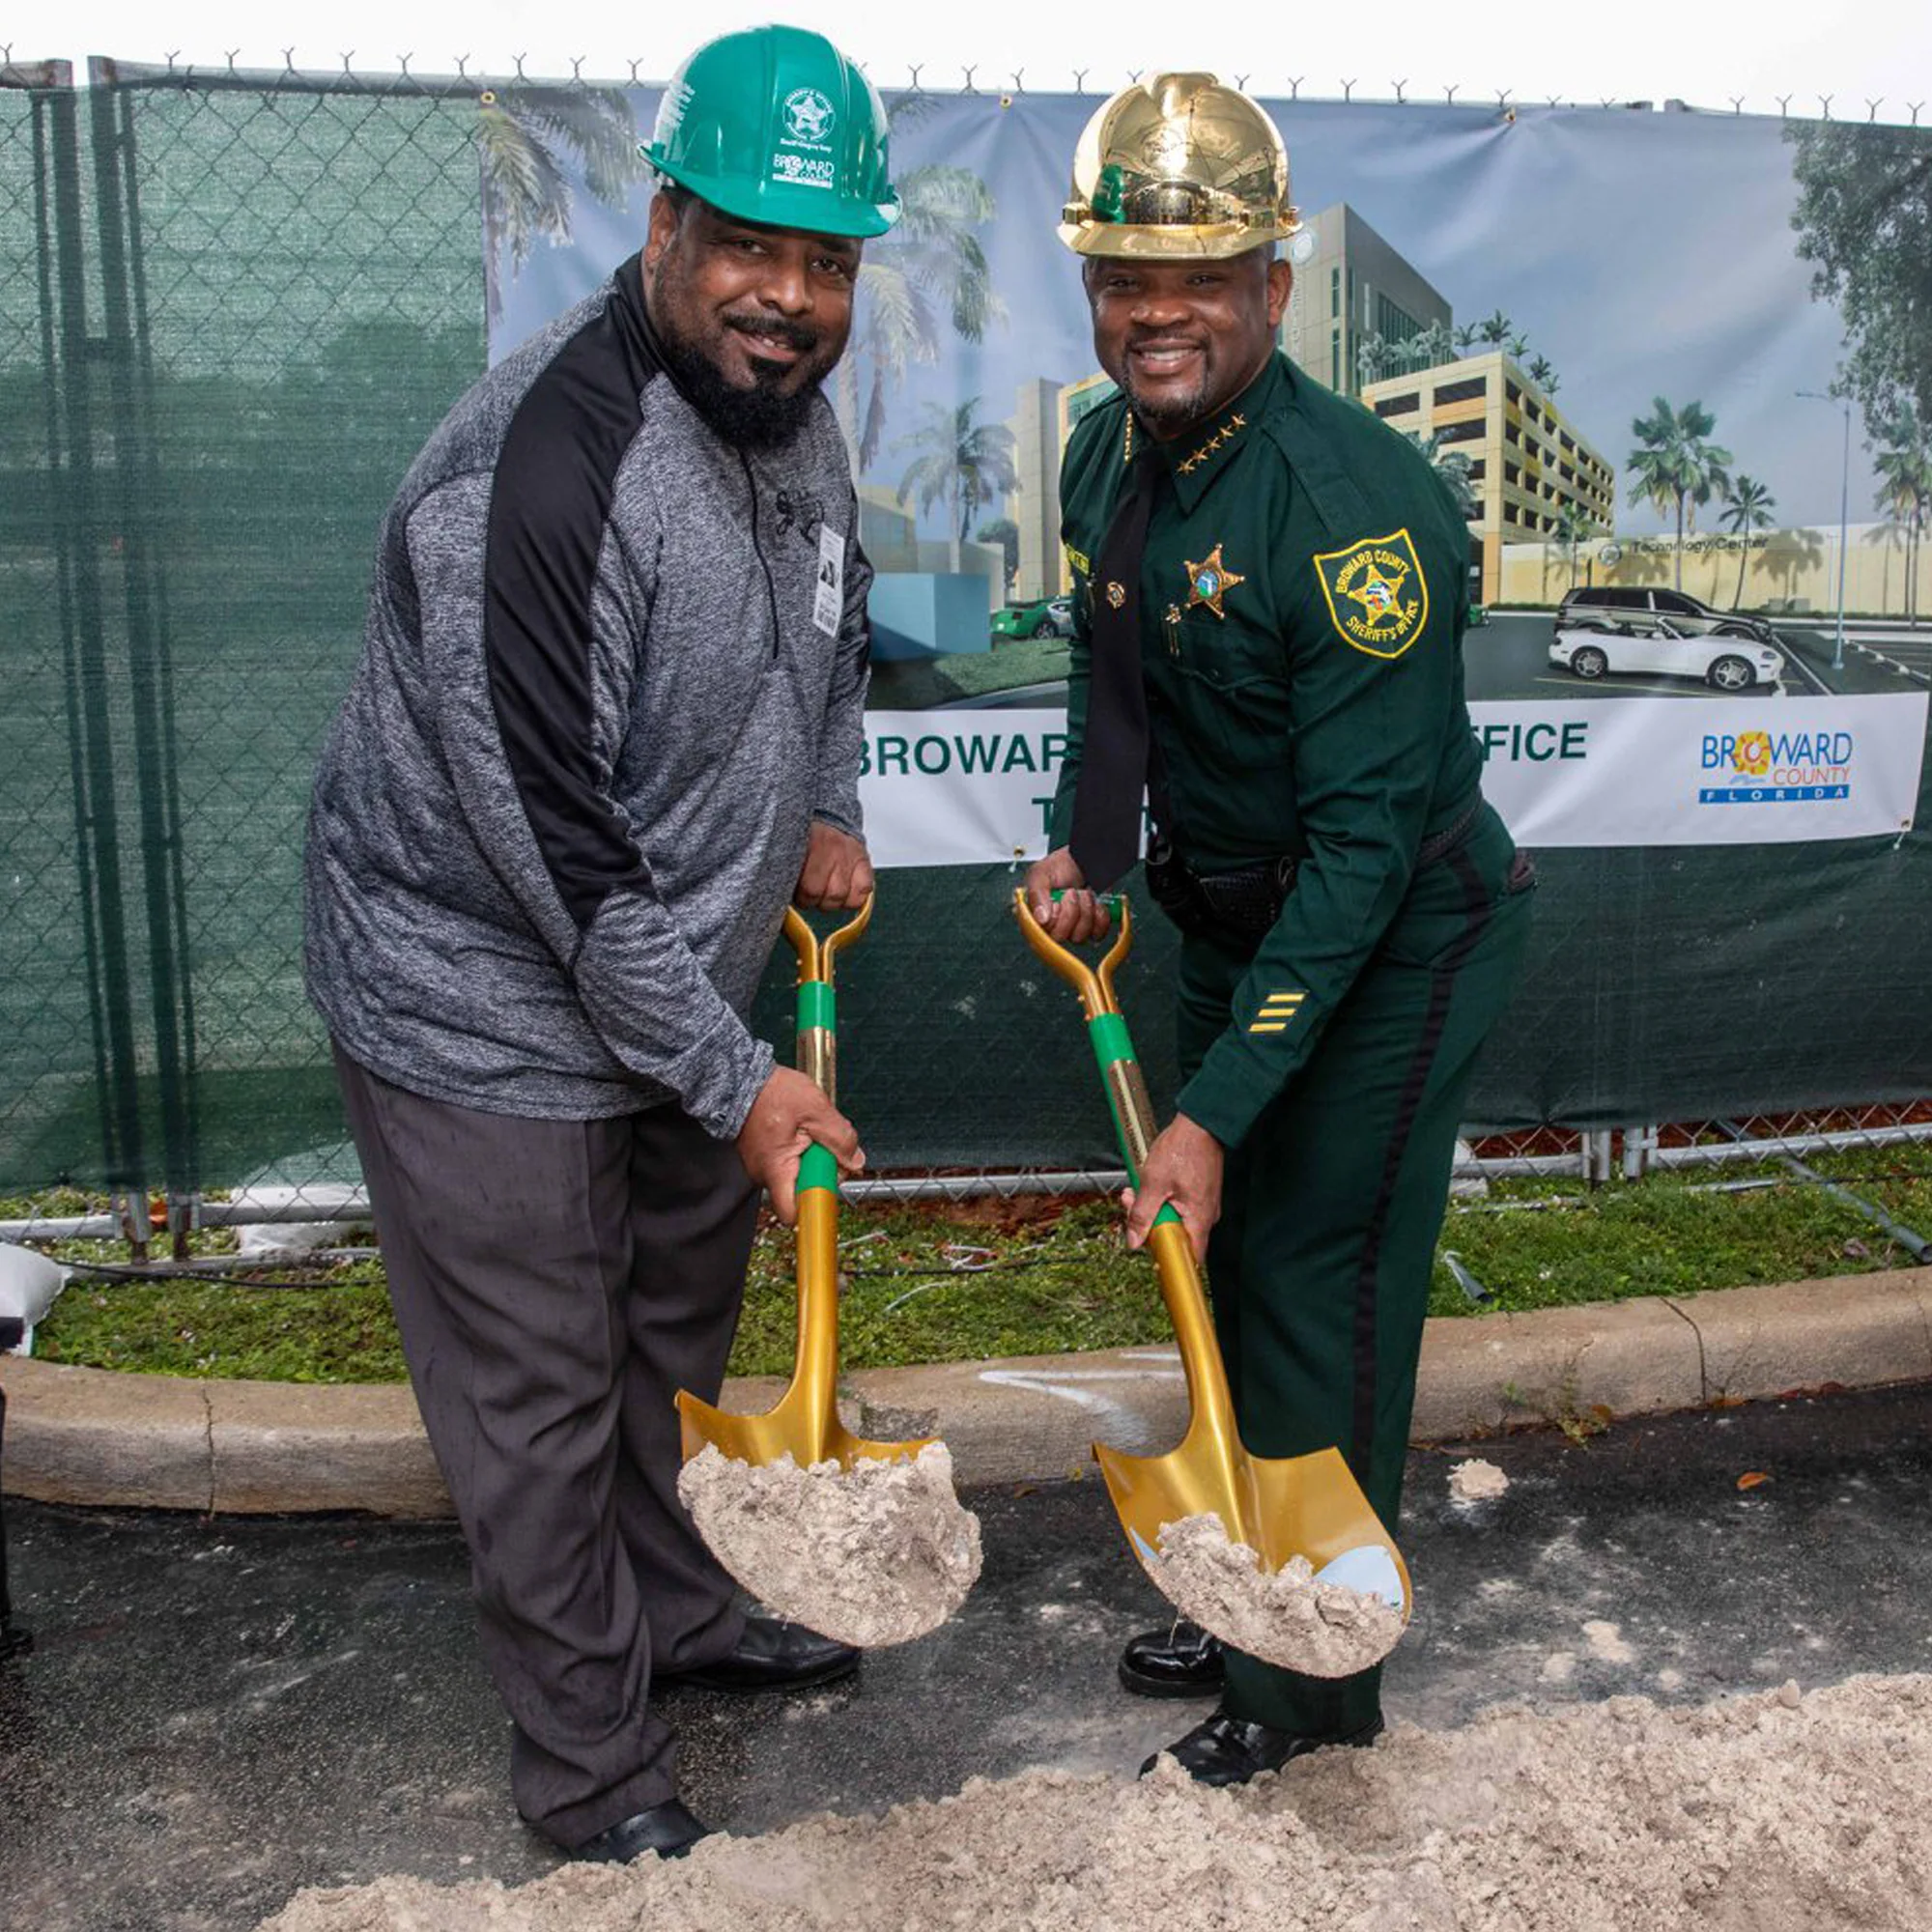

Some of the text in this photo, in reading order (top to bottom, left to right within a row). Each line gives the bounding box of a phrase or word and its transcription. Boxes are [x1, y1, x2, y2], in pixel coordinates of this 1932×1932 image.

[1715, 536, 1769, 551] Center
[1374, 549, 1411, 575] COUNTY
[1469, 723, 1588, 761] FICE
[1702, 731, 1853, 774] BROWARD
[1773, 767, 1850, 785] COUNTY
